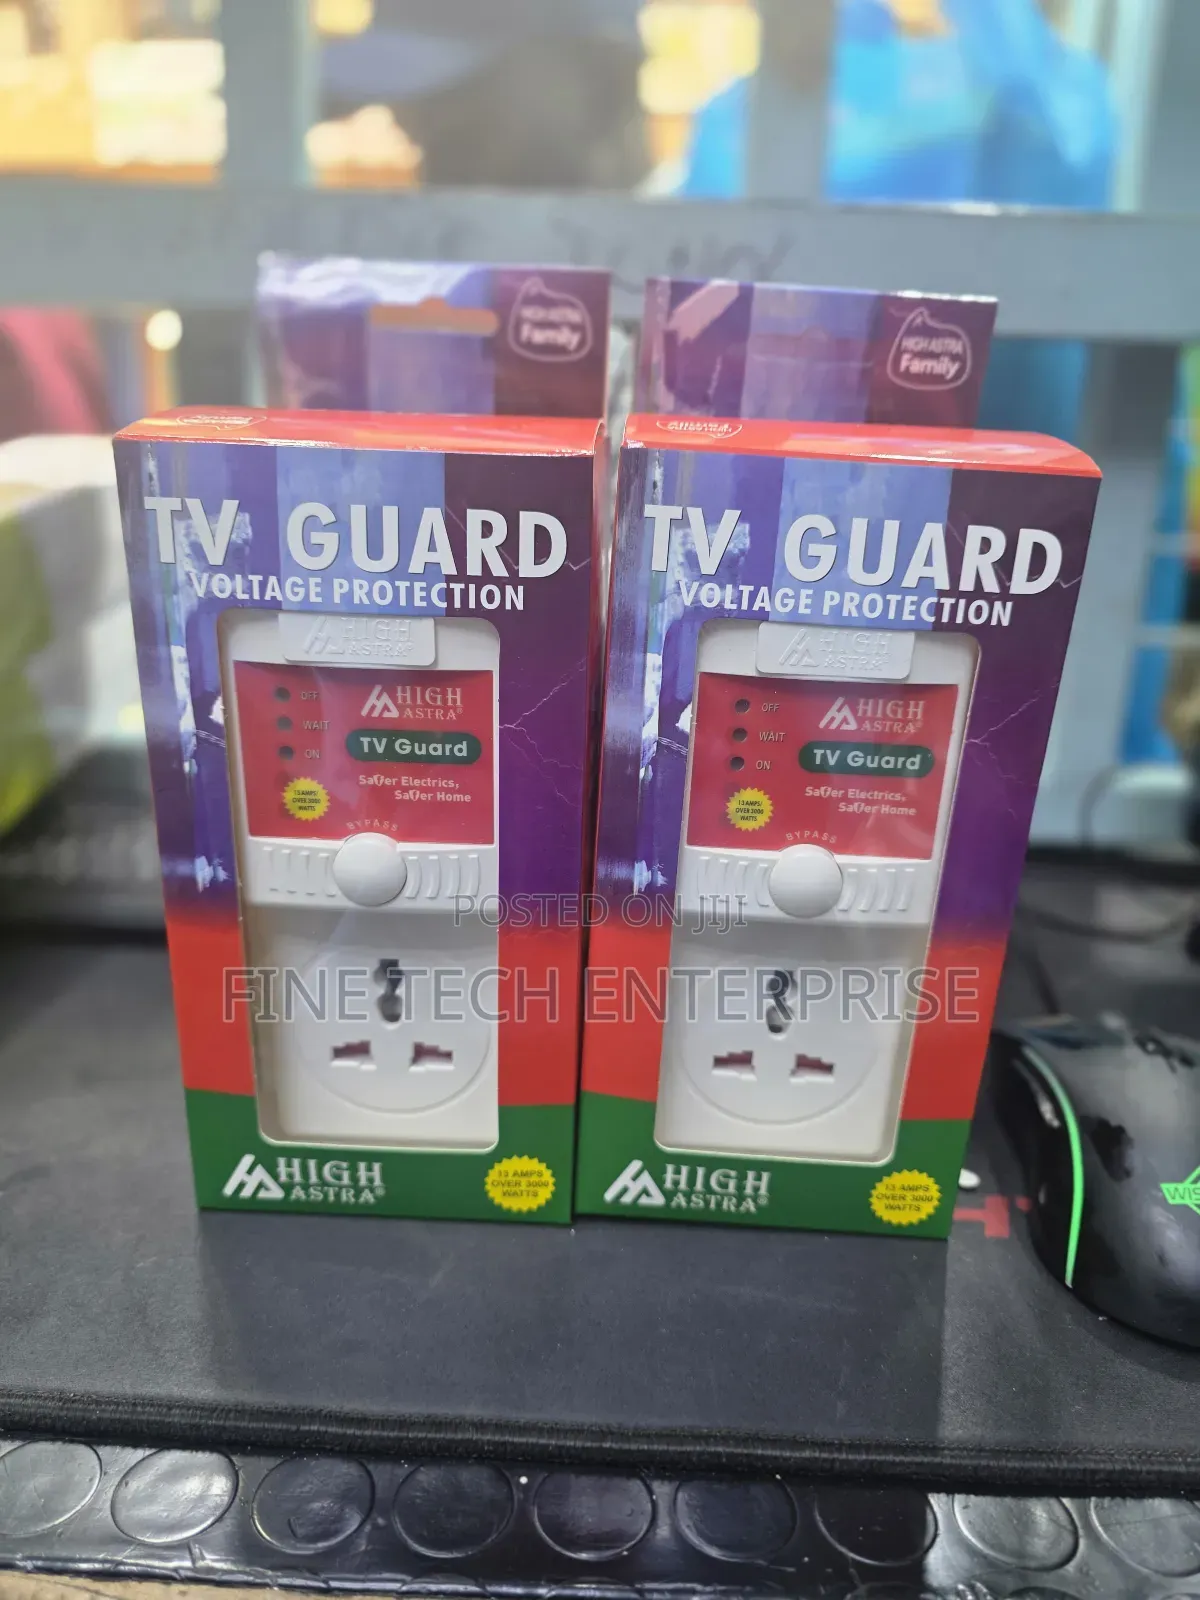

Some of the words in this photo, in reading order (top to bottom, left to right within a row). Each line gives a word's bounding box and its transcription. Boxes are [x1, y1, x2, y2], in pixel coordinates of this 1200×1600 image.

[899, 352, 961, 380] Family
[144, 496, 239, 566] TV
[286, 502, 567, 578] GUARD
[644, 504, 741, 575] TV
[783, 514, 1063, 595] GUARD
[189, 571, 323, 604] VOLTAGE
[333, 579, 525, 611] PROTECTION
[679, 580, 813, 615] VOLTAGE
[822, 589, 1013, 627] PROTECTION
[300, 690, 319, 701] OFF
[396, 685, 462, 706] HIGH
[761, 702, 780, 713] OFF
[856, 699, 924, 720] HIGH
[302, 720, 330, 731] WAIT
[759, 731, 786, 743] WAIT
[359, 736, 387, 755] TV
[394, 737, 468, 757] Guard
[304, 748, 321, 760] ON
[813, 748, 843, 767] TV
[847, 750, 921, 771] Guard
[755, 758, 771, 771] ON
[436, 791, 472, 803] Home
[735, 807, 750, 815] OVER
[881, 804, 917, 817] Home
[346, 819, 398, 832] BYPASS
[740, 815, 759, 823] WATTS
[786, 830, 837, 844] BYPASS
[276, 1157, 384, 1187] HIGH
[511, 1169, 544, 1178] AMPS
[491, 1179, 523, 1188] OVER
[525, 1179, 550, 1189] 3000
[664, 1163, 771, 1196] HIGH
[502, 1189, 539, 1198] WATTS
[899, 1184, 930, 1193] AMPS
[875, 1192, 908, 1201] OVER
[909, 1194, 934, 1203] 3000
[884, 1203, 921, 1213] WATTS
